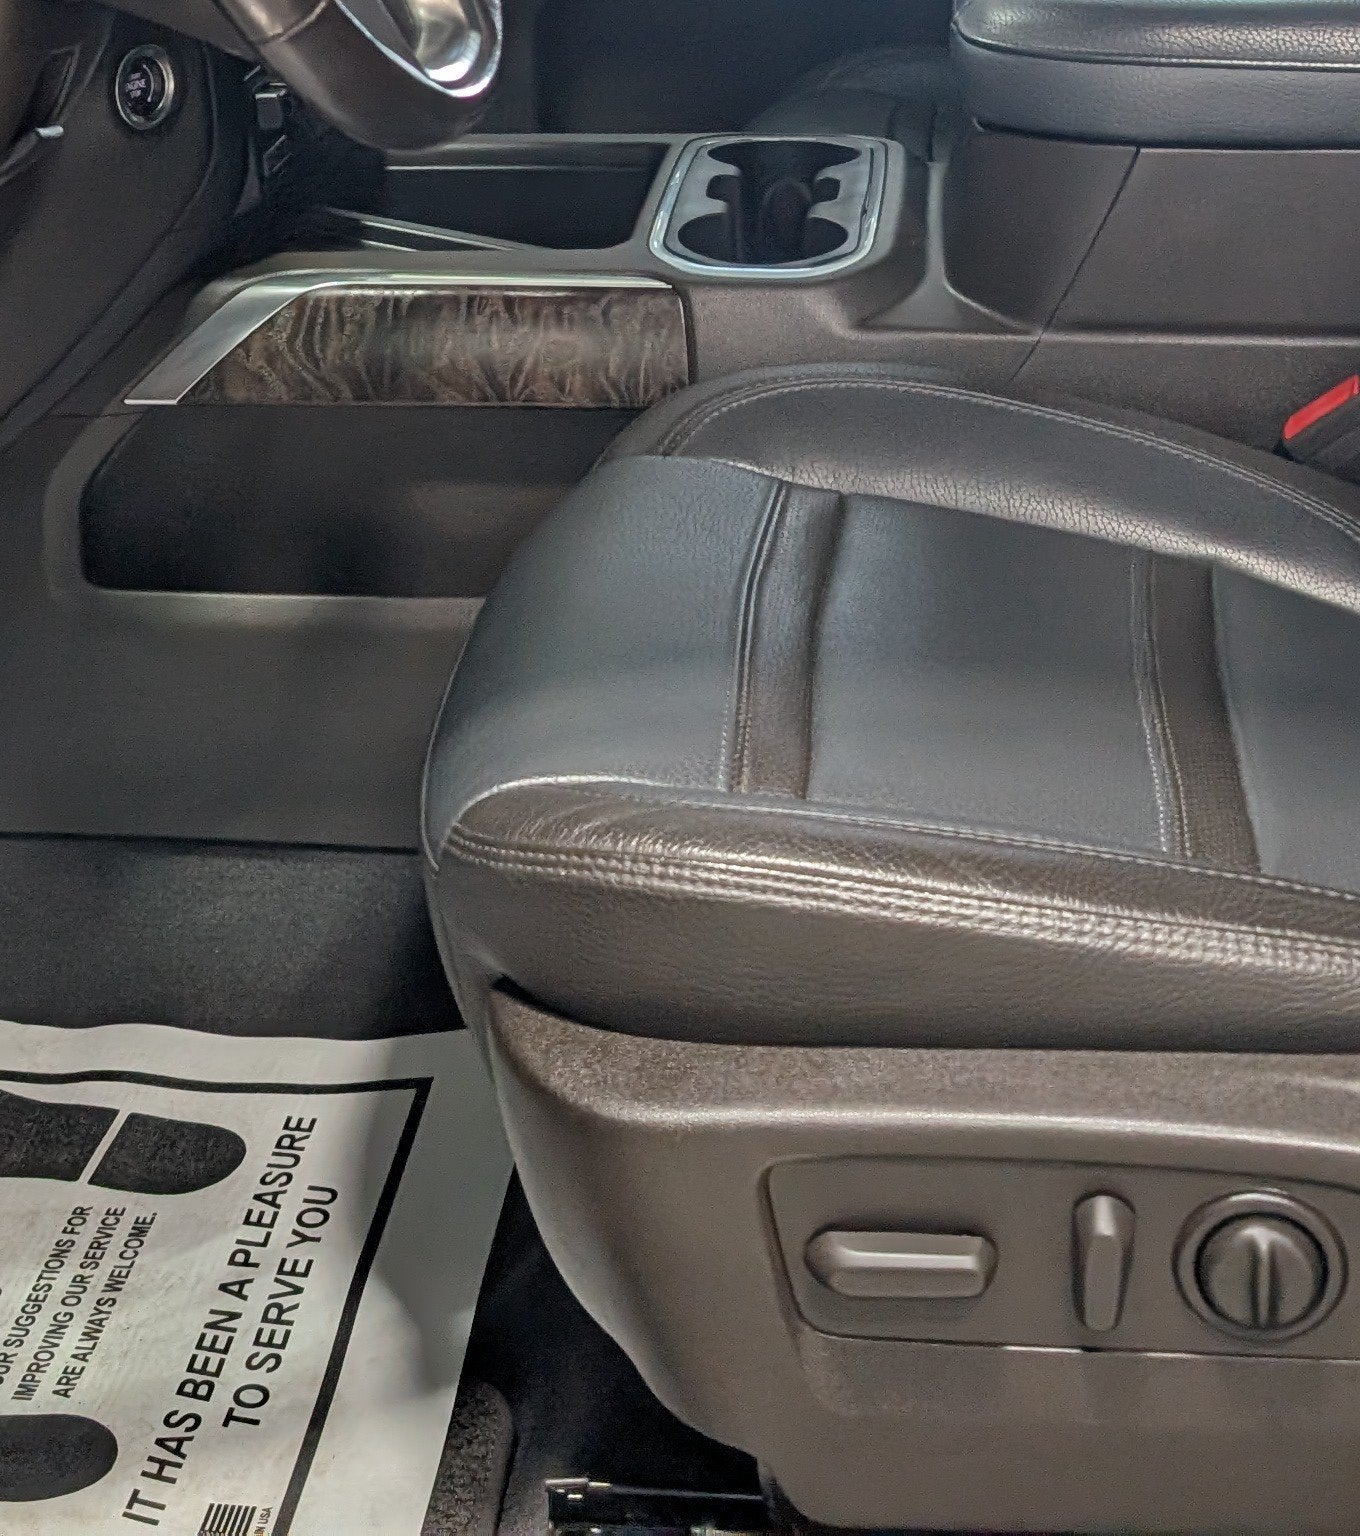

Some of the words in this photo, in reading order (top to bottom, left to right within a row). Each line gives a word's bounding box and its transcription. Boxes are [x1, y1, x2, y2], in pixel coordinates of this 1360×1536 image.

[227, 1115, 319, 1268] PLEASURE
[285, 1184, 339, 1250] YOU
[2, 1238, 76, 1348] SUGGESTIONS
[61, 1206, 94, 1235] FOR
[11, 1311, 75, 1401] IMPROVING
[60, 1273, 94, 1307] OUR
[79, 1206, 127, 1271] SERVICE
[51, 1365, 86, 1399] ARE
[70, 1296, 117, 1363] ALWAYS
[101, 1212, 158, 1294] WELCOME.
[217, 1277, 256, 1302] A
[245, 1257, 315, 1374] SERVE
[175, 1309, 244, 1403] BEEN
[140, 1409, 203, 1485] HAS
[221, 1383, 271, 1428] TO
[121, 1488, 167, 1527] IT
[257, 1506, 273, 1525] USA
